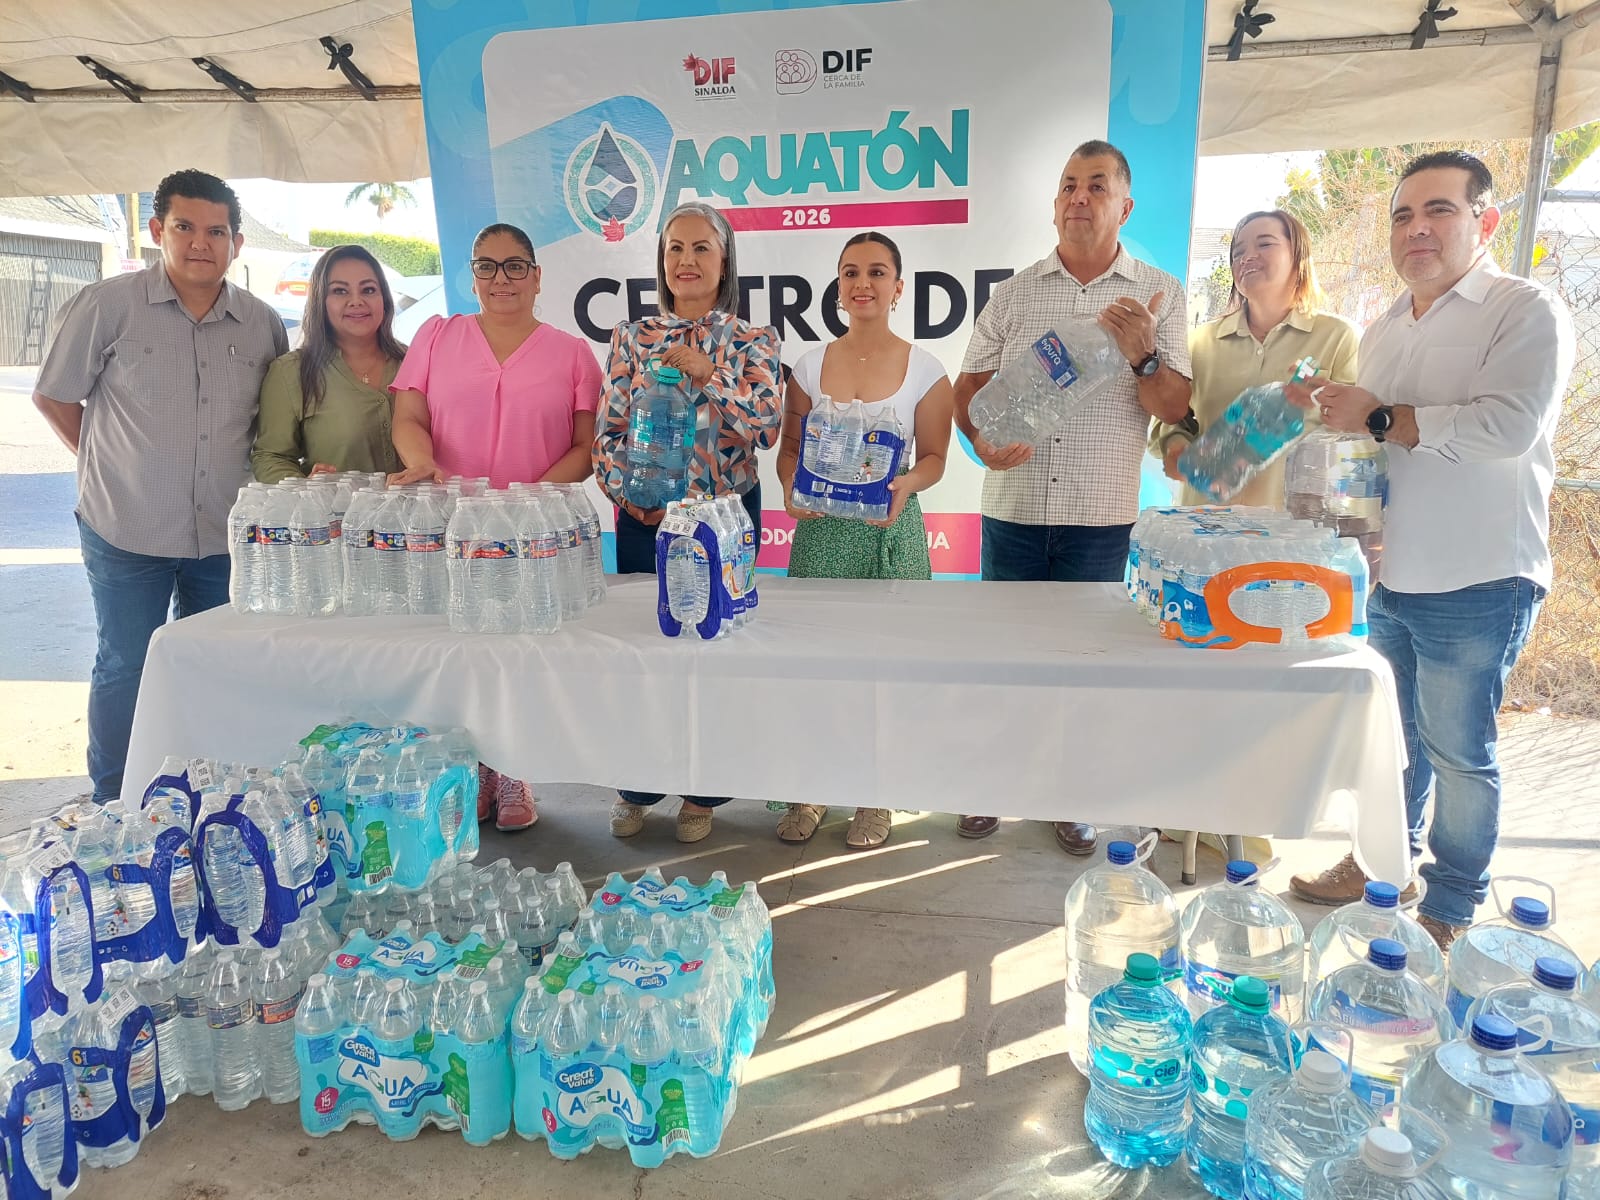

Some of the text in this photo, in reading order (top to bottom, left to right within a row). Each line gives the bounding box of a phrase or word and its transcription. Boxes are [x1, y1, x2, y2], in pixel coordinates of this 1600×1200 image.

[822, 47, 873, 74] DIF
[694, 57, 736, 87] DIF
[823, 73, 862, 82] CERCA DE
[694, 86, 737, 97] SINALOA
[823, 80, 866, 89] LA FAMILIA
[656, 108, 970, 234] AQUATÓN
[781, 207, 832, 227] 2026
[573, 273, 850, 344] CETR
[867, 431, 877, 443] 6
[744, 532, 752, 544] 6
[309, 799, 319, 814] 6
[72, 1049, 82, 1066] 6
[559, 1066, 595, 1084] Great
[1154, 1061, 1180, 1078] ciel
[351, 1063, 416, 1097] AGUA
[567, 1077, 595, 1090] Value
[320, 1092, 331, 1108] 15
[568, 1087, 634, 1121] AGUA
